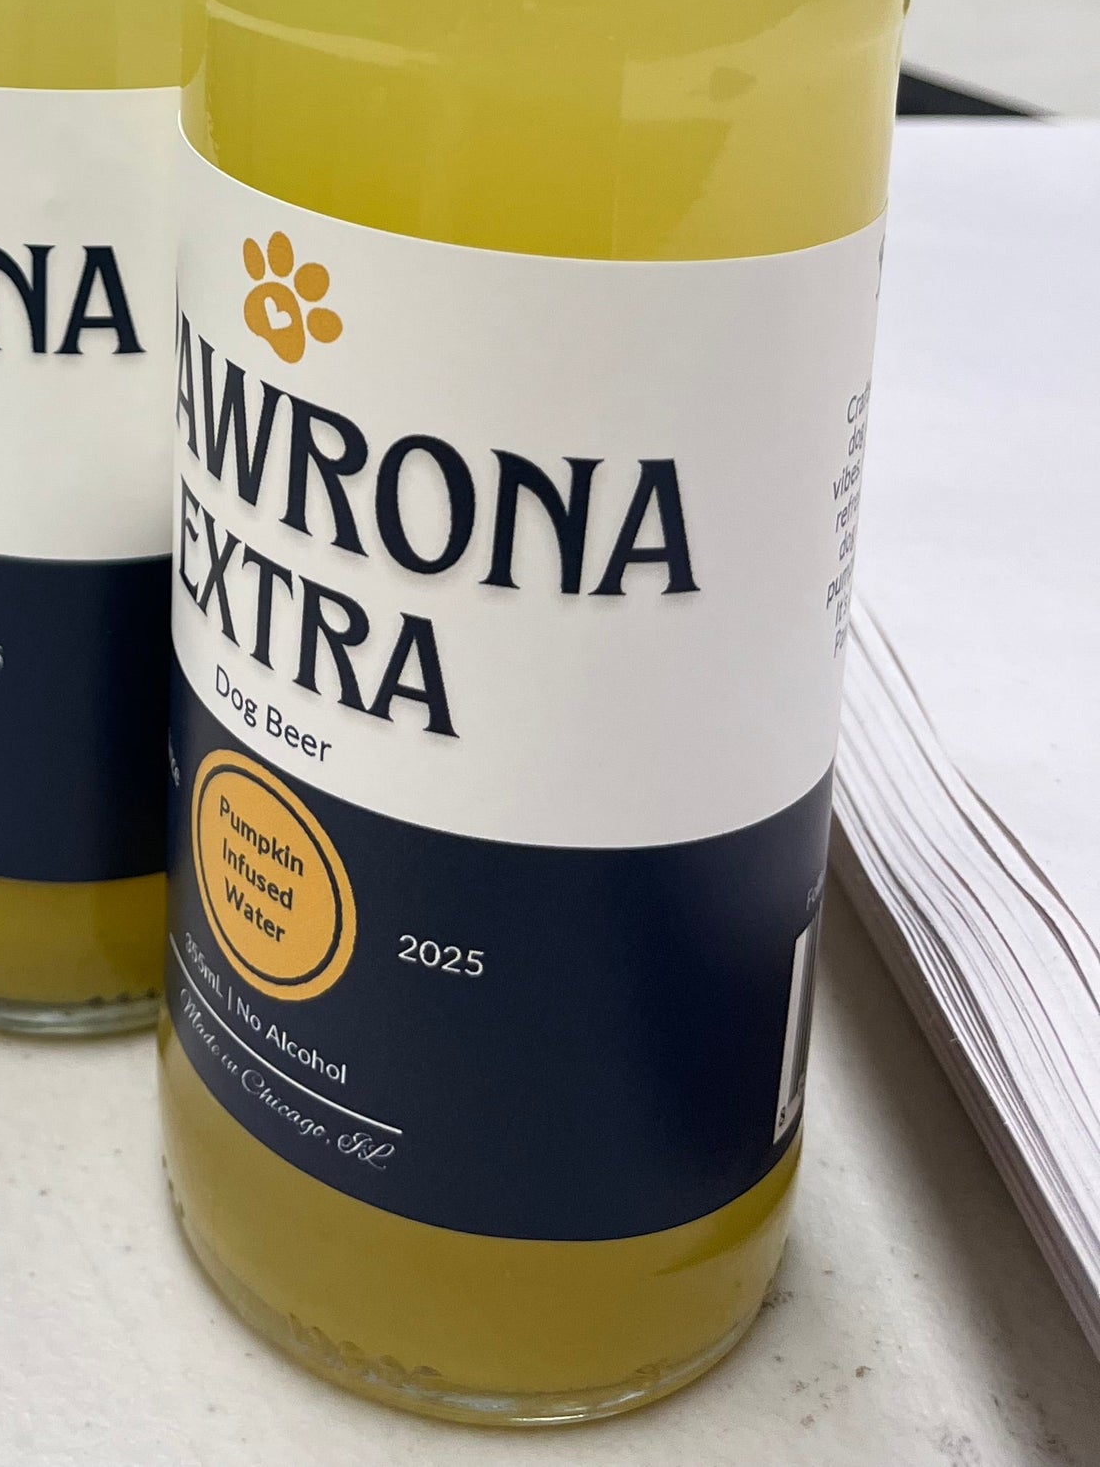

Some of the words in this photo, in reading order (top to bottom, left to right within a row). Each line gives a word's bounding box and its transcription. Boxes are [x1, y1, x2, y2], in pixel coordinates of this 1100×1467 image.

[175, 266, 701, 597] AWRONA
[178, 473, 460, 739] EXTRA
[215, 664, 259, 729] Dog
[265, 704, 333, 763] Beer
[218, 794, 305, 878] Pumpkin
[222, 837, 293, 912] Infused
[224, 876, 286, 943] Water
[398, 934, 485, 978] 2025
[236, 996, 262, 1032] No
[265, 1023, 348, 1085] Alcohol
